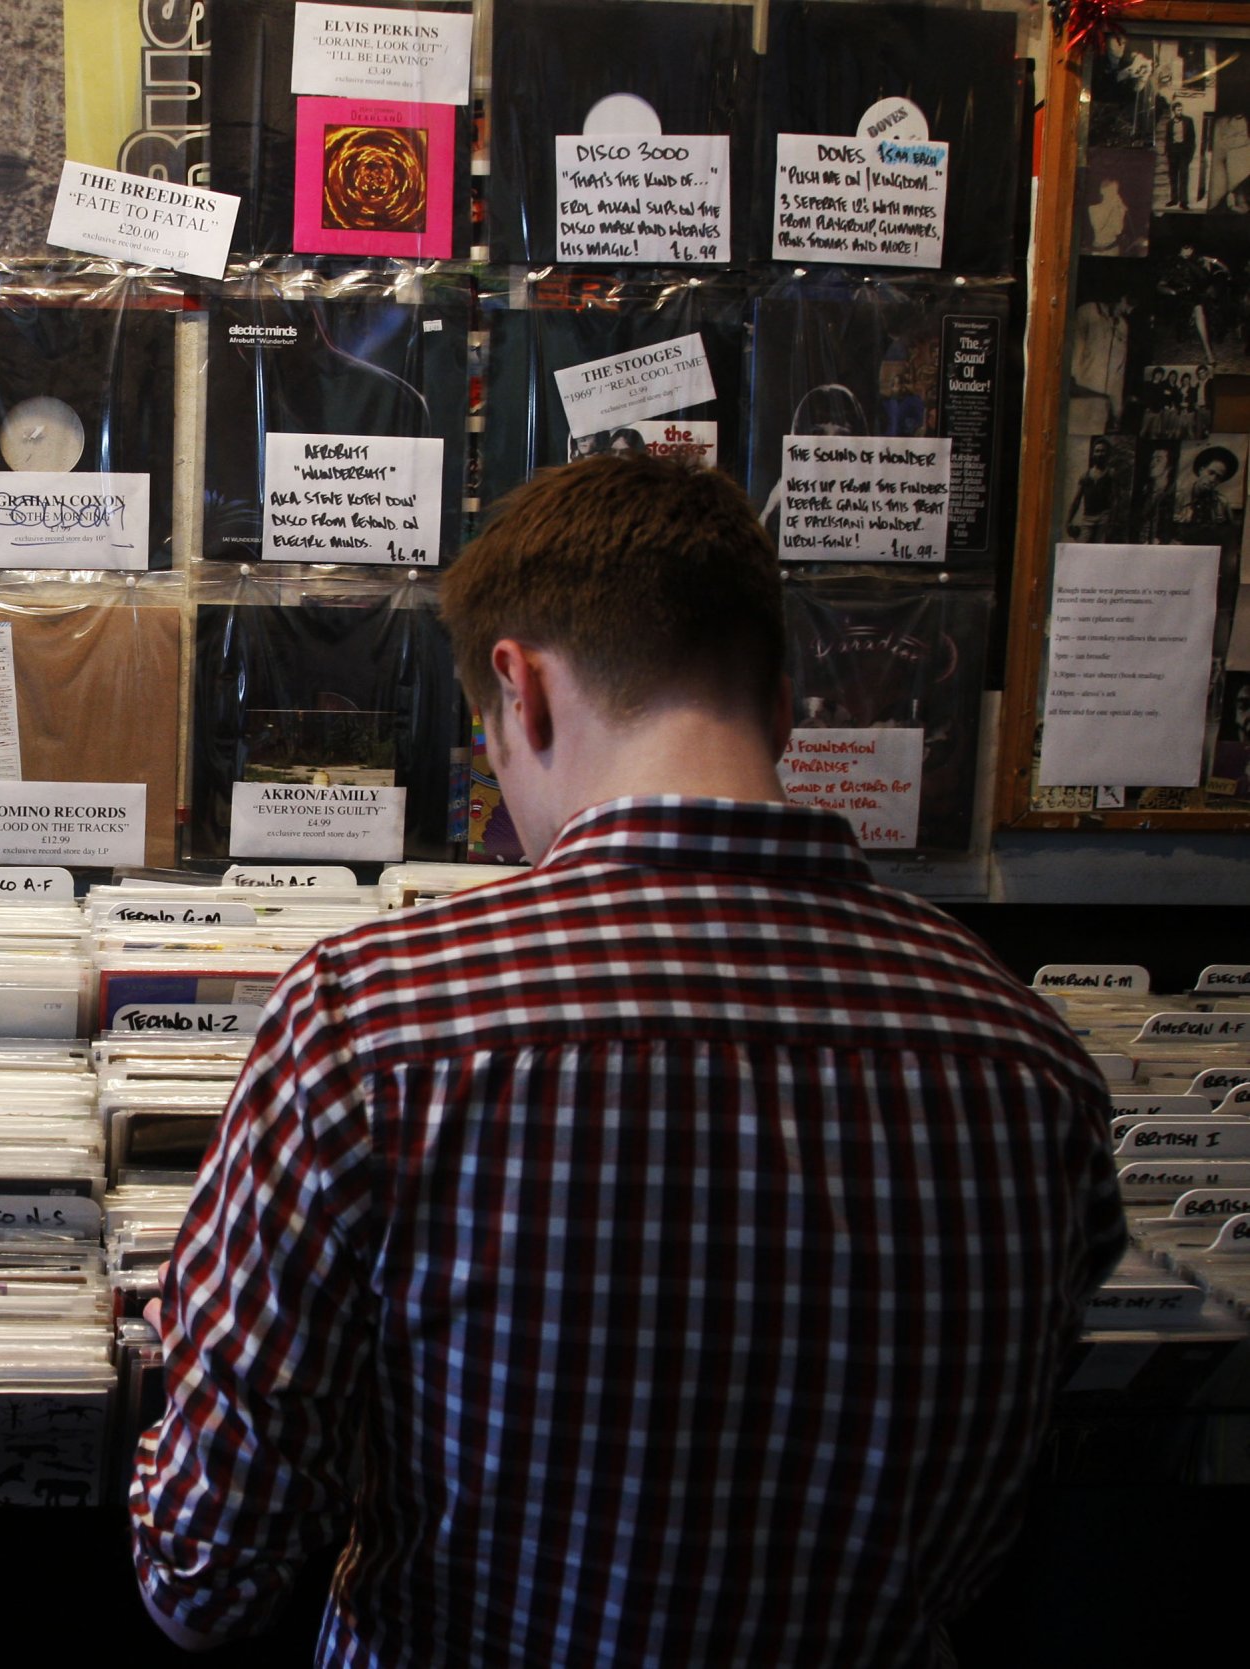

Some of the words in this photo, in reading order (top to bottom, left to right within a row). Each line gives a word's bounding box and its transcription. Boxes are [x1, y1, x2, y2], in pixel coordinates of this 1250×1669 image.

[325, 20, 369, 34] ELVIS
[373, 24, 439, 38] PERKINS
[368, 67, 391, 76] £3.49
[577, 145, 630, 162] DISCO
[638, 142, 689, 161] 3000
[818, 144, 865, 164] DOVES
[80, 172, 117, 191] THE
[121, 181, 217, 213] BREEDERS
[69, 192, 120, 214] "FATE
[125, 203, 148, 220] TO
[153, 210, 219, 233] FATAL"
[118, 223, 159, 241] £20.00
[83, 231, 117, 246] exclusive
[118, 240, 142, 251] record
[143, 244, 160, 253] store
[162, 247, 175, 258] day
[178, 251, 189, 259] EP
[670, 241, 717, 261] £6.99
[229, 325, 265, 336] electric
[265, 326, 297, 337] minds
[582, 365, 613, 383] THE
[615, 345, 682, 374] STOOGES
[954, 352, 985, 364] Sound
[564, 387, 597, 403] "1969"
[605, 375, 639, 391] "REAL
[641, 366, 673, 381] COOL
[676, 355, 706, 372] TIME"
[963, 366, 974, 378] Of
[949, 380, 990, 392] Wonder!
[664, 425, 694, 442] the
[305, 444, 369, 460] AFROBUTT
[787, 445, 810, 462] THE
[814, 447, 857, 462] SOUND
[860, 449, 874, 461] OF
[879, 448, 936, 467] WONDER
[273, 535, 327, 548] ELECTRIC
[799, 740, 875, 754] FOUNDATION
[262, 789, 379, 801] AKRON/FAMILY
[54, 806, 126, 818] RECORDS
[253, 805, 321, 815] "EVERYONE
[325, 806, 334, 815] IS
[337, 806, 386, 815] GUILTY"
[32, 823, 48, 831] ON
[51, 823, 75, 832] THE
[77, 823, 129, 833] TRACKS"
[308, 819, 331, 827] £4.99
[41, 835, 70, 844] £12.99
[23, 879, 53, 891] A-F
[1041, 973, 1100, 987] AMERICAN
[1104, 974, 1132, 988] G-M
[121, 1010, 193, 1032] TECHNO
[198, 1014, 239, 1032] N-Z
[1152, 1021, 1212, 1036] AMERICAN
[1219, 1022, 1246, 1034] A-F
[1134, 1131, 1198, 1147] BRITISH
[1206, 1132, 1221, 1147] I
